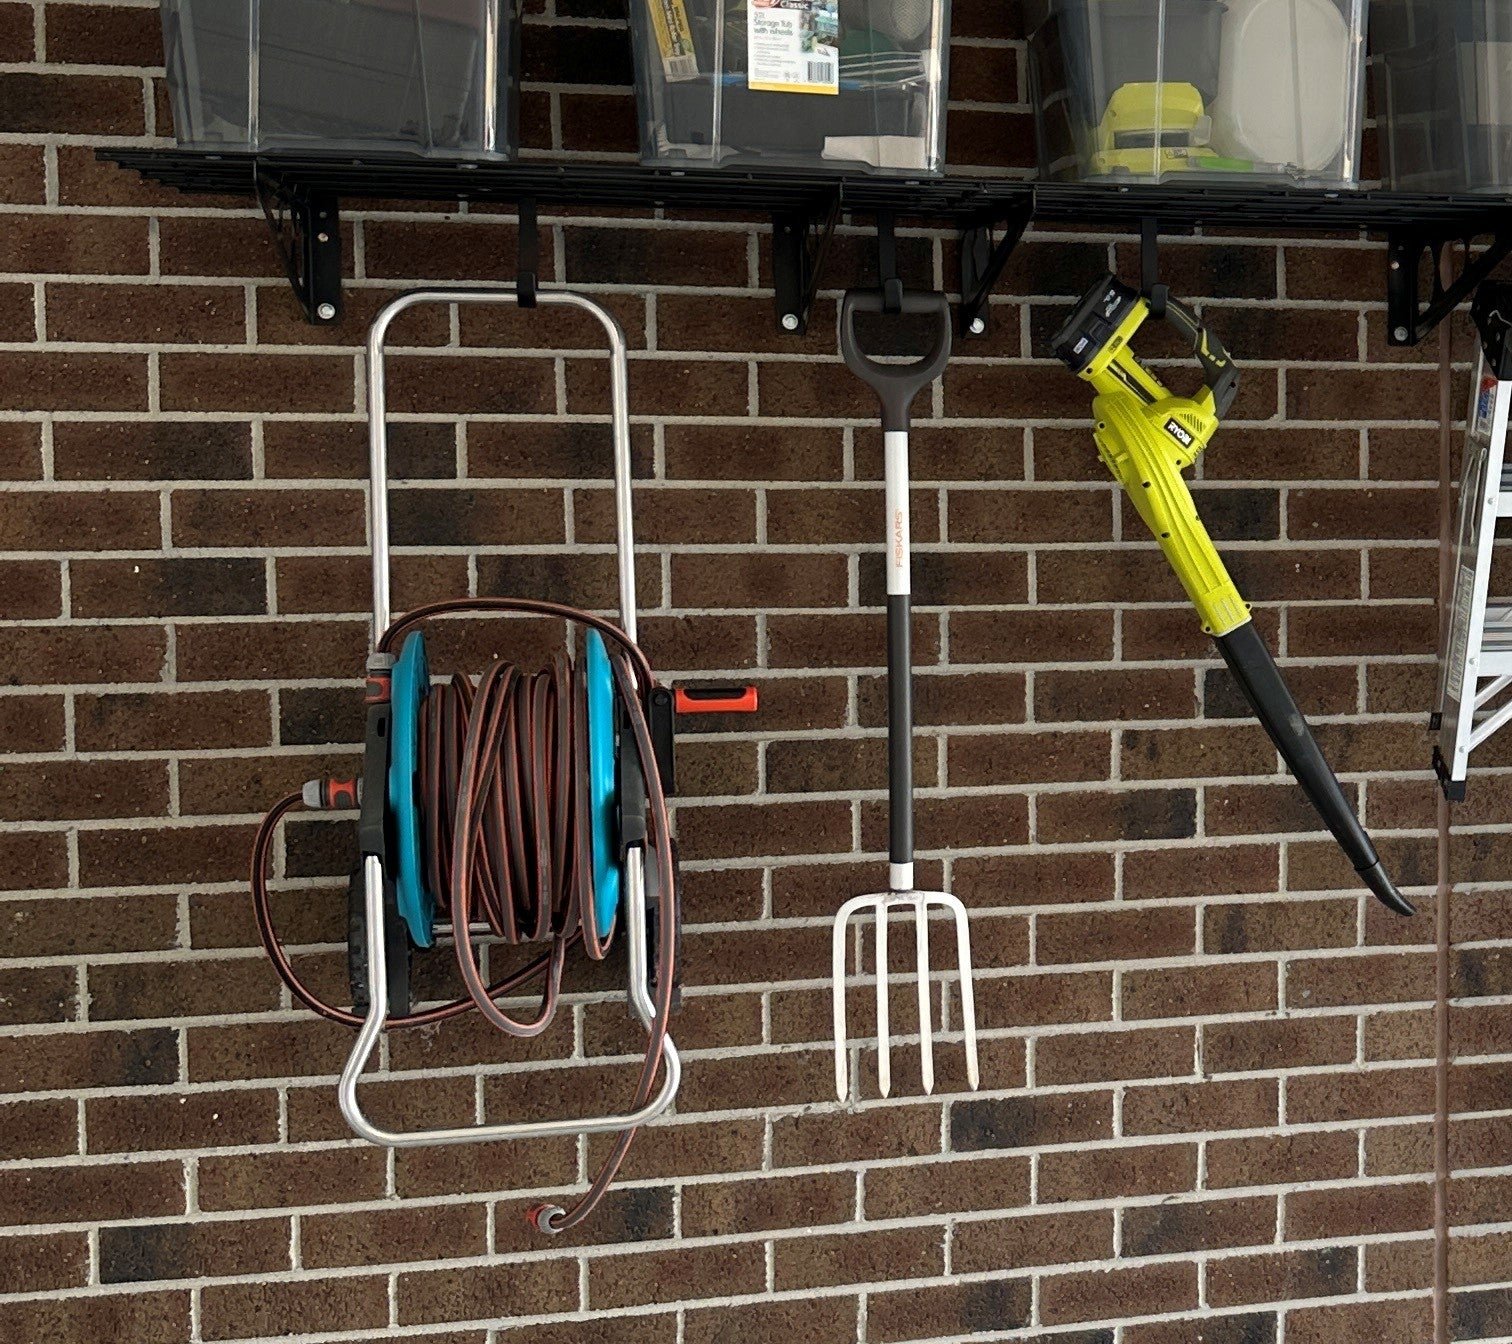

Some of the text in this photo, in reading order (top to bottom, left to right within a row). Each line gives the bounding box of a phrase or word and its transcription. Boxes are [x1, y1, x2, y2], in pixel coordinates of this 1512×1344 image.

[780, 0, 809, 10] Classic
[1167, 421, 1192, 446] RYOBI
[894, 508, 903, 568] FISKARS
